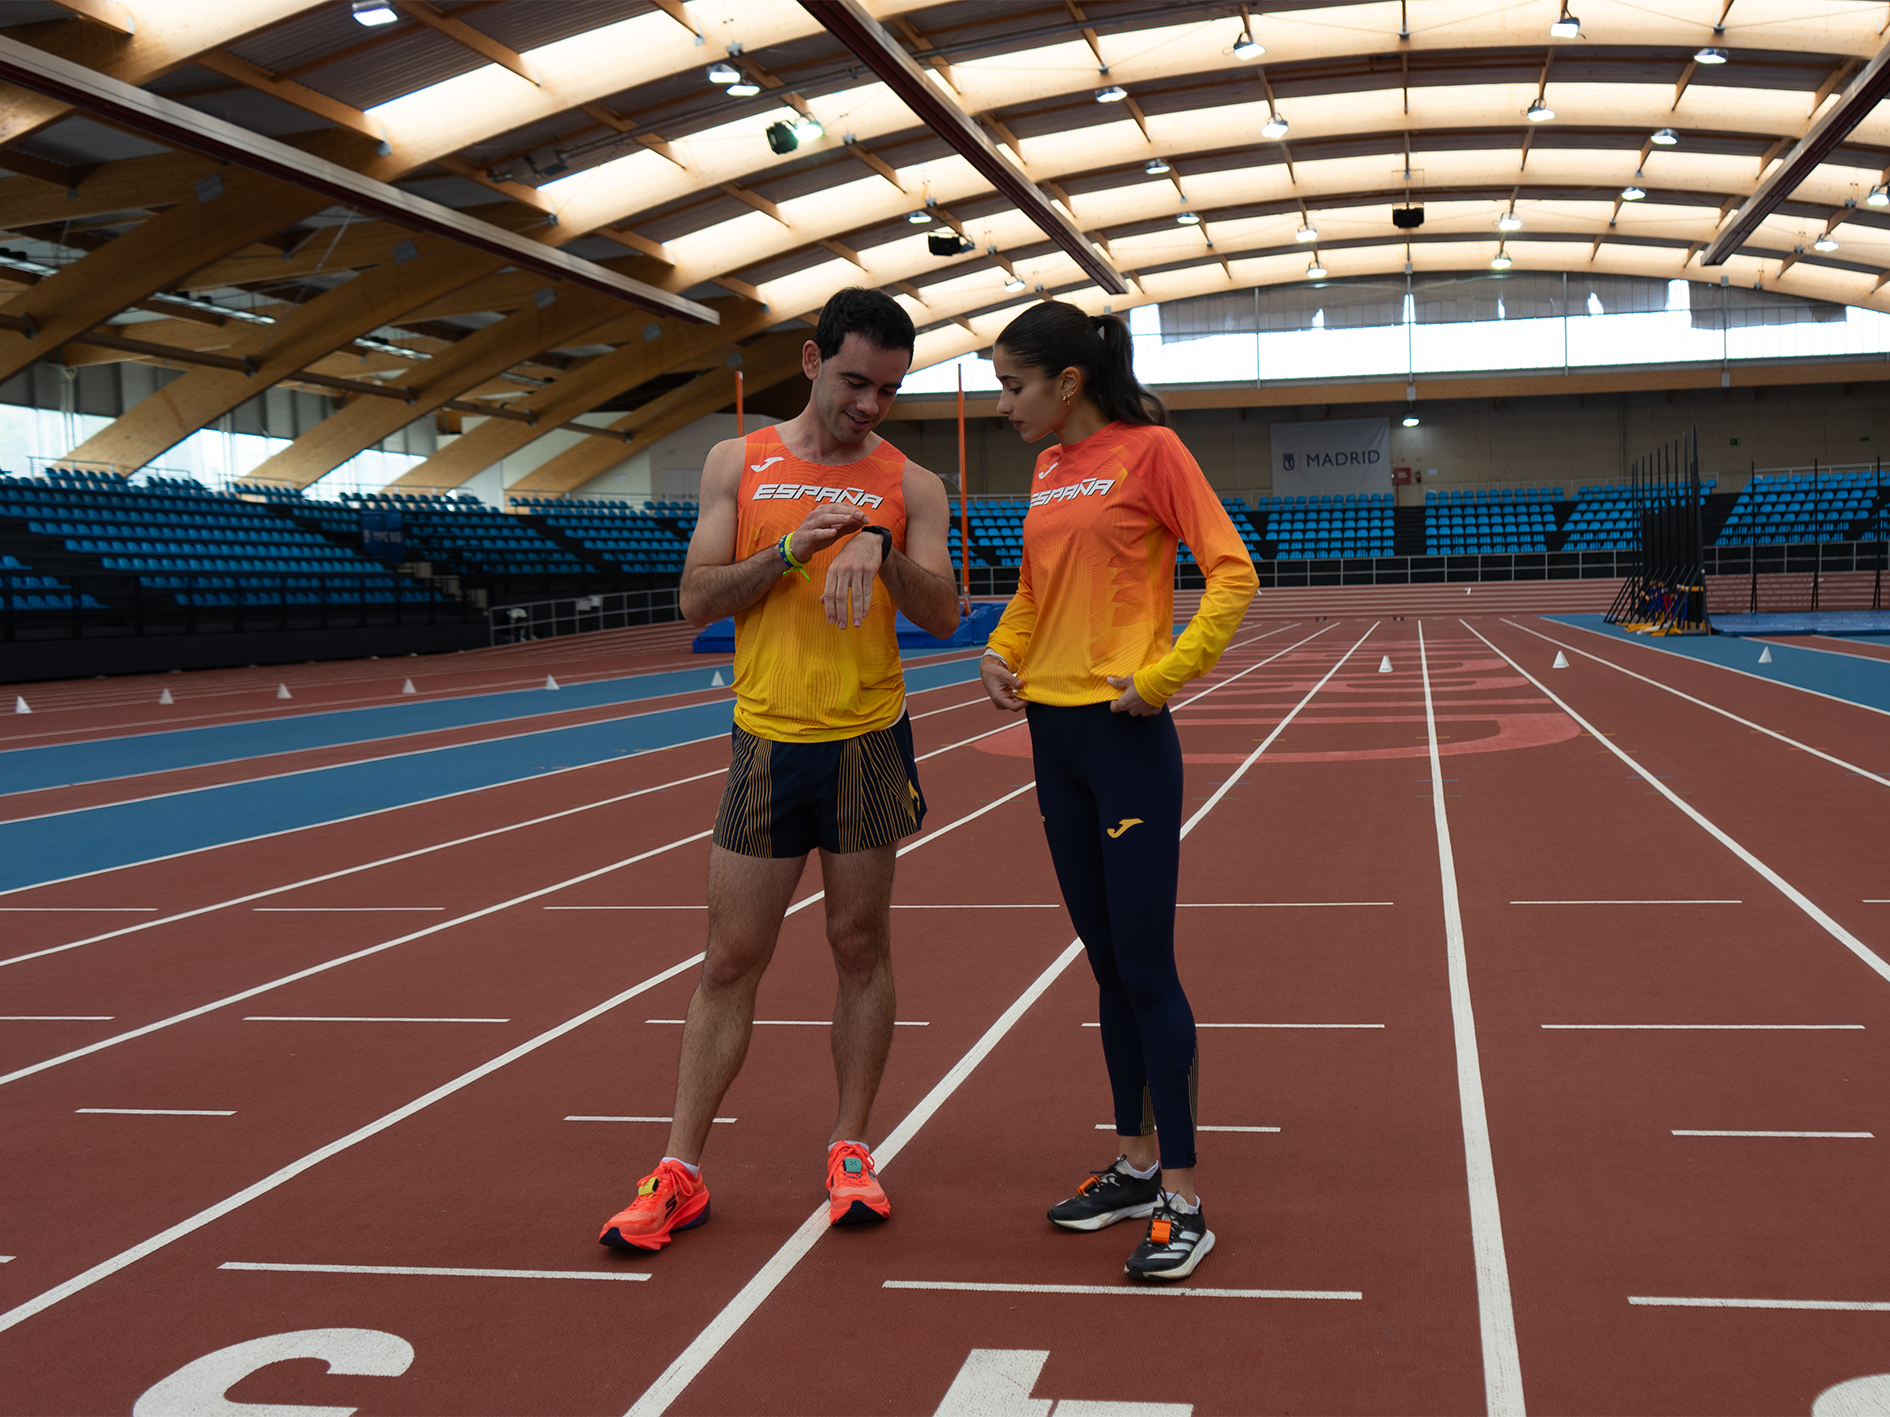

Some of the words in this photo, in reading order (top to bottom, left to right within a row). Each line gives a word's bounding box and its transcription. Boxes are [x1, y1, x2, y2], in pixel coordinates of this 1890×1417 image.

[1306, 450, 1381, 468] MADRID
[752, 484, 884, 509] ESPAÑA
[1030, 478, 1116, 508] ESPAÑA
